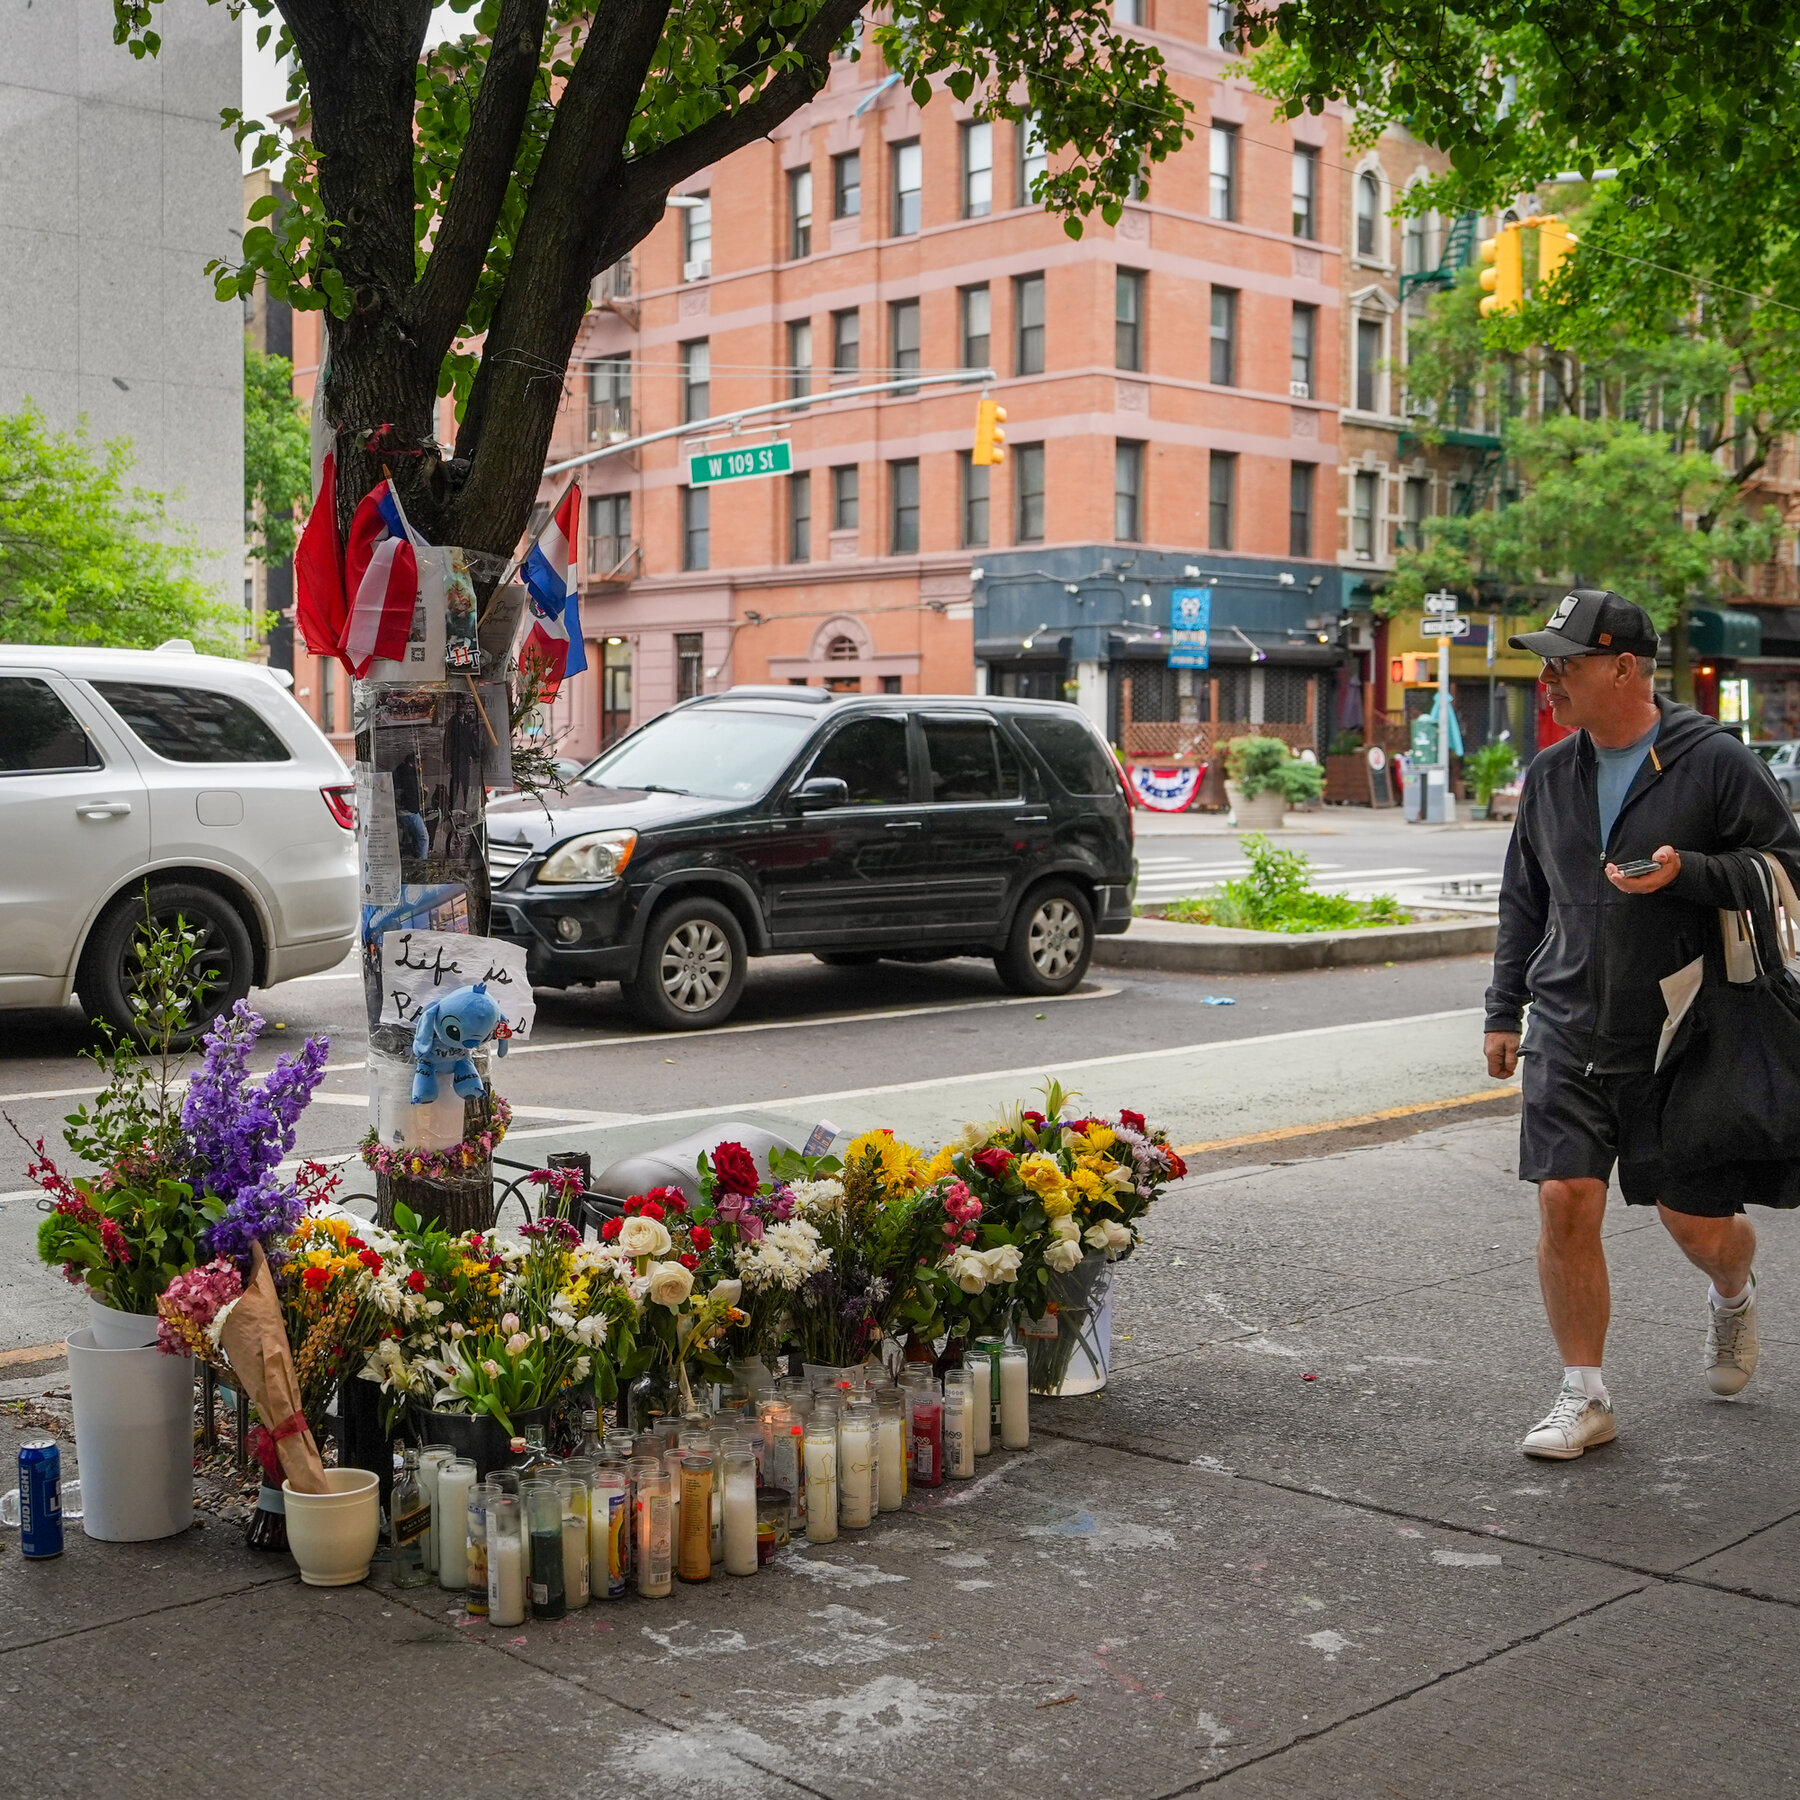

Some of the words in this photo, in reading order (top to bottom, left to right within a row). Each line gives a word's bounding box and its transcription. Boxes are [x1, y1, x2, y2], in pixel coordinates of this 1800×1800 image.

[708, 457, 722, 477] W
[728, 452, 754, 474] 109
[759, 449, 774, 470] St
[446, 644, 481, 667] LHT
[395, 933, 462, 986] Life
[482, 959, 513, 985] is
[21, 1467, 30, 1504] LIGHT
[22, 1505, 31, 1532] BUD
